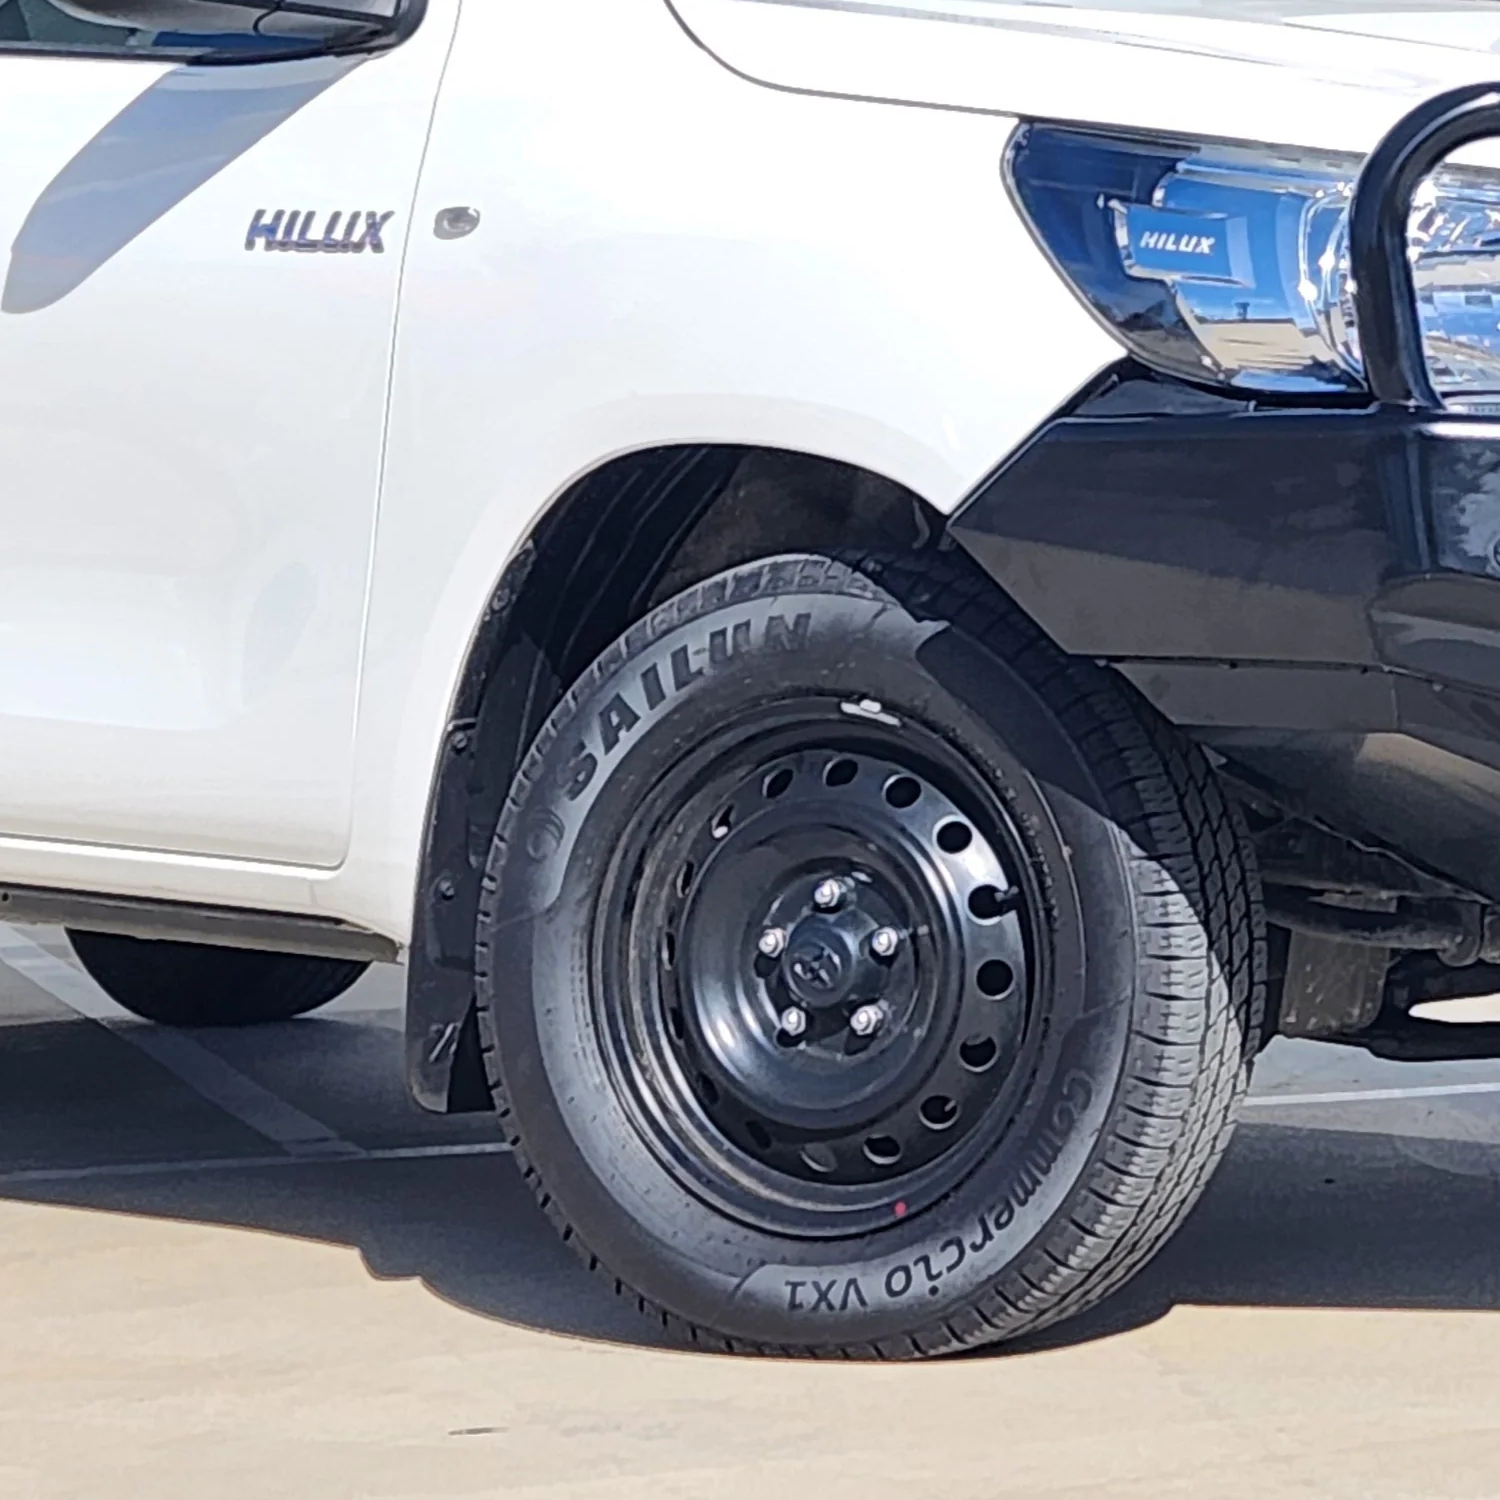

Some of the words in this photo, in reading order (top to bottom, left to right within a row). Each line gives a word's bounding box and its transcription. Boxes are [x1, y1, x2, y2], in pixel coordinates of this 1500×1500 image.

[244, 208, 396, 254] HILUX
[1139, 230, 1217, 255] HILUX
[556, 612, 812, 801] SAILUN
[884, 1068, 1094, 1298] Commercio
[784, 1276, 868, 1312] VX1
